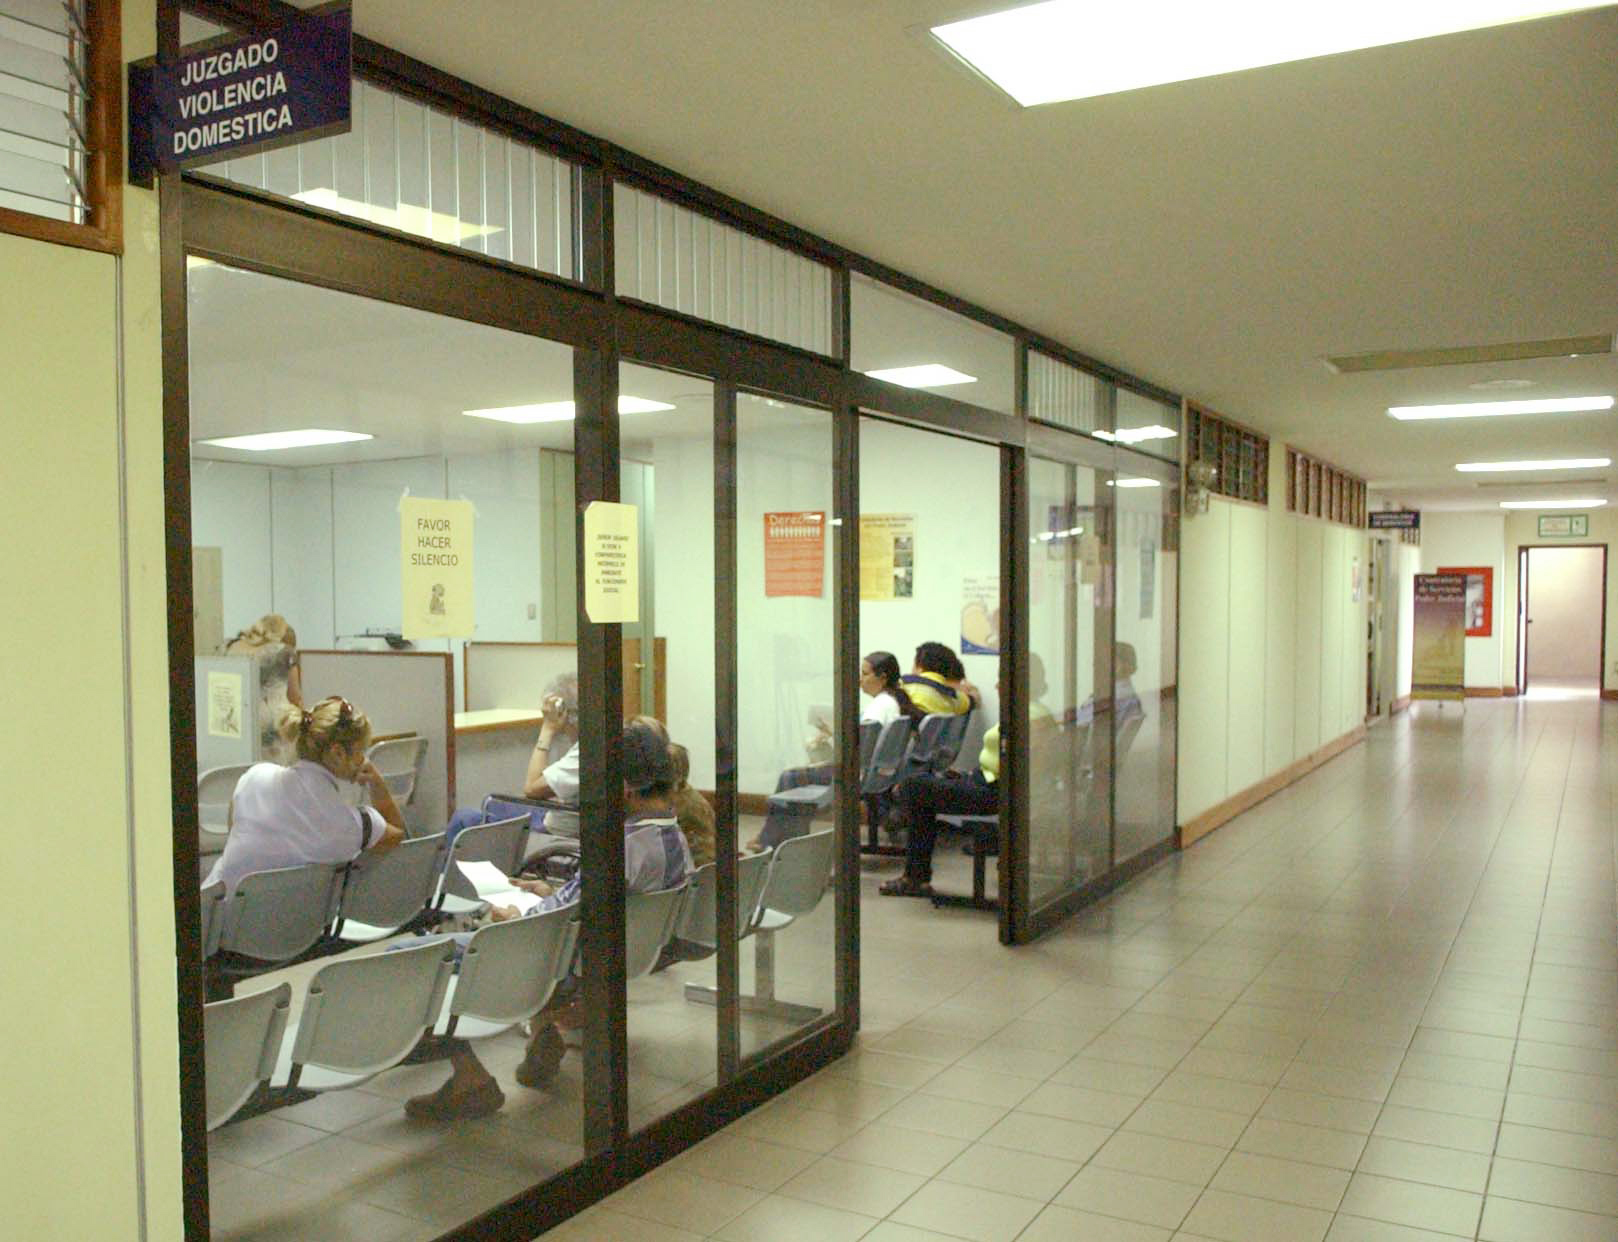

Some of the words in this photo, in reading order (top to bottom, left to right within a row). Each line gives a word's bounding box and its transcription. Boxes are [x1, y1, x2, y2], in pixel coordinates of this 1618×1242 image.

[181, 38, 278, 86] JUZGADO
[179, 71, 287, 119] VIOLENCIA
[174, 104, 293, 154] DOMESTICA
[417, 518, 451, 531] FAVOR
[417, 536, 451, 548] HACER
[411, 553, 458, 566] SILENCIO
